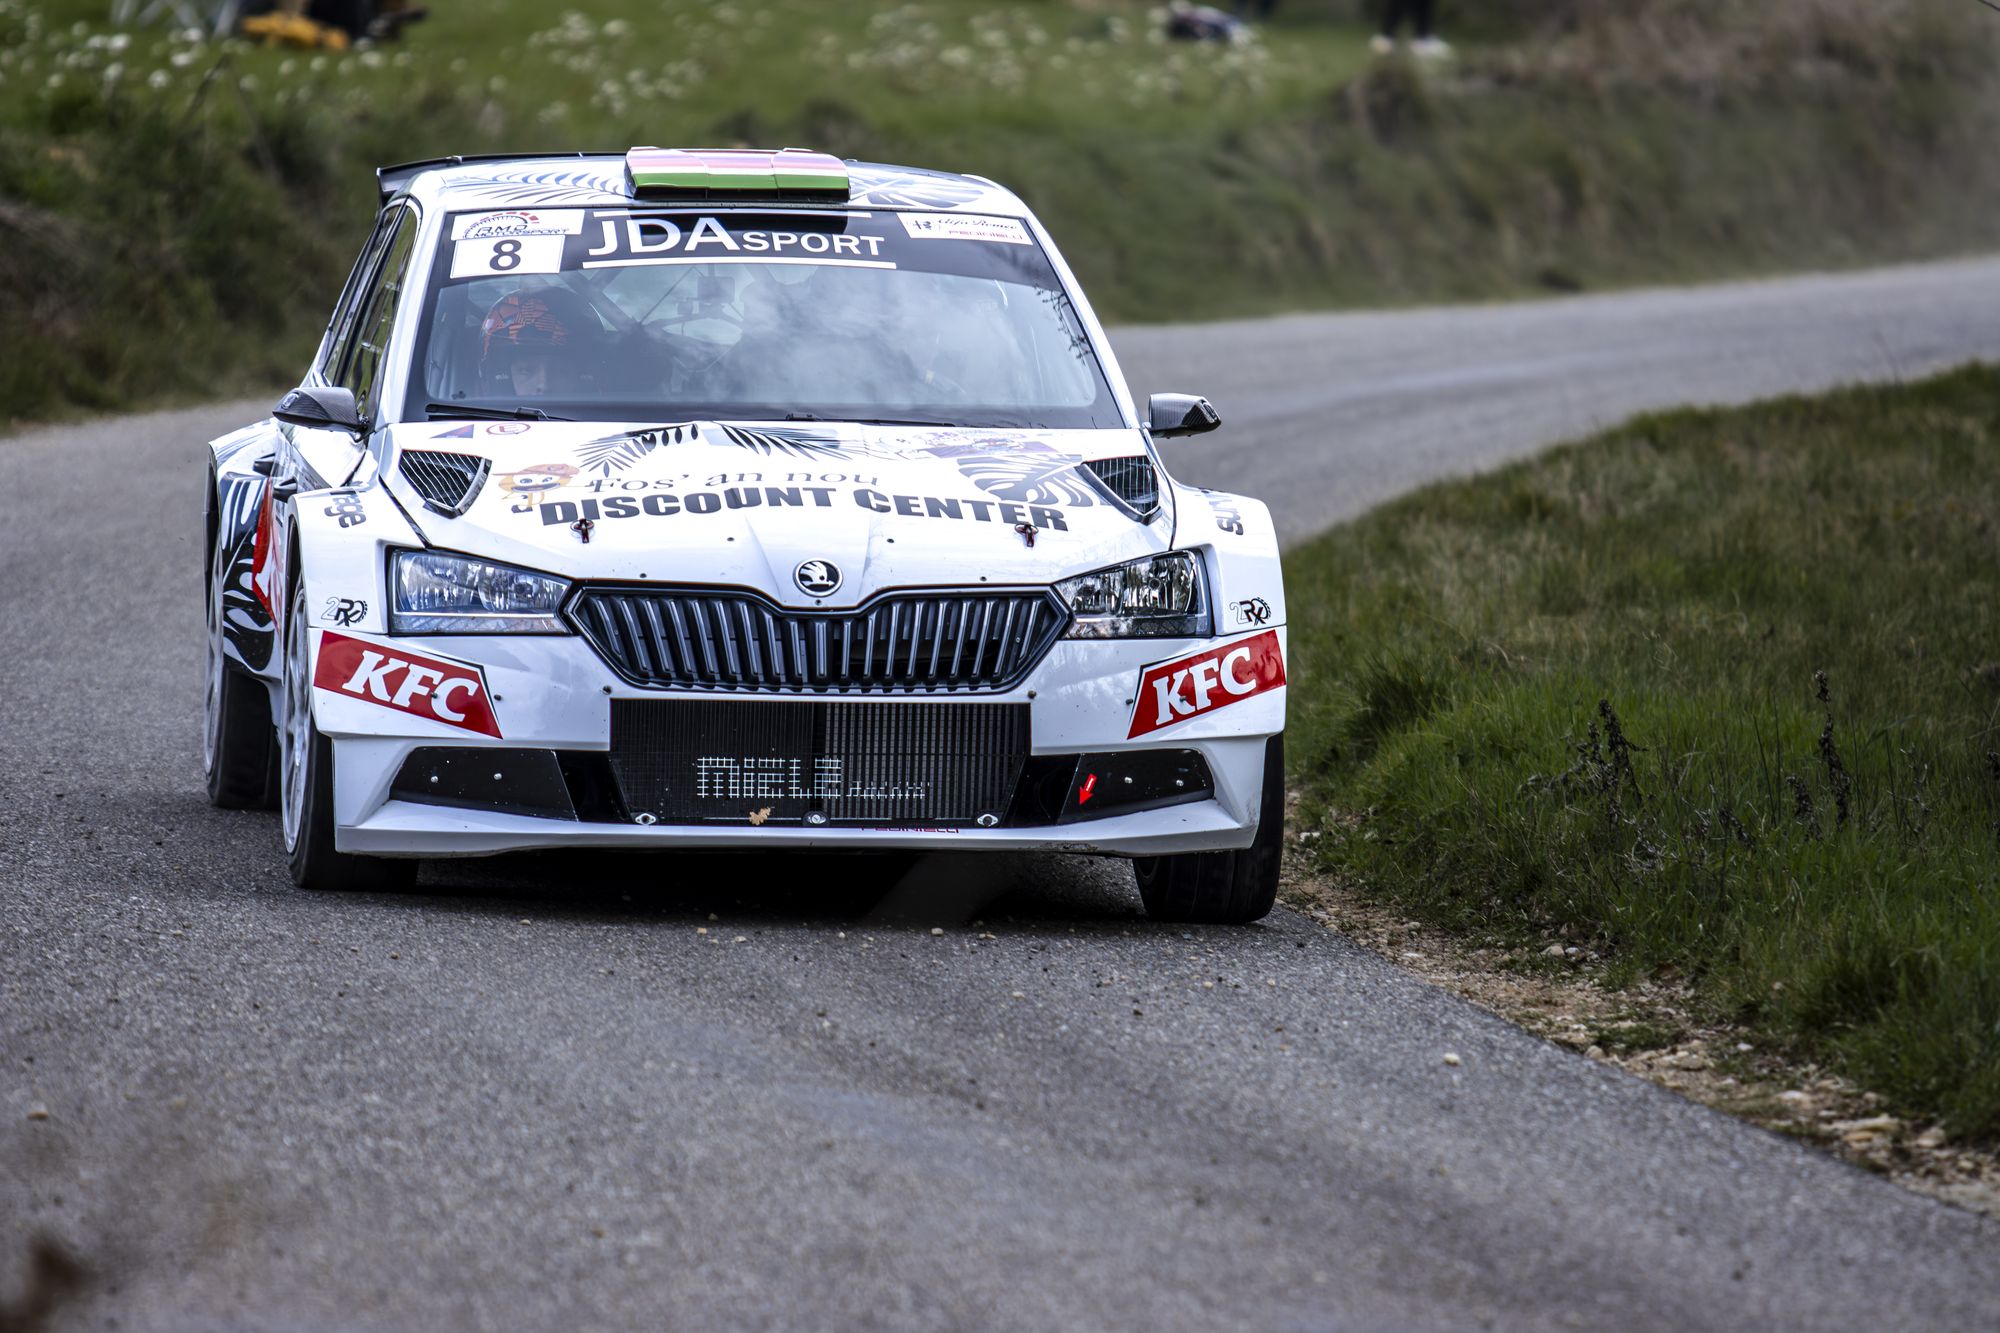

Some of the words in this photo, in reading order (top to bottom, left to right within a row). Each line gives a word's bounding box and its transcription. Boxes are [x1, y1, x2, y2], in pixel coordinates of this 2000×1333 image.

[489, 239, 522, 271] 8
[589, 217, 741, 256] JDA
[742, 231, 885, 256] SPORT
[705, 472, 764, 487] an
[786, 472, 878, 486] nou
[539, 487, 837, 526] DISCOUNT
[853, 488, 1069, 532] CENTER
[341, 650, 479, 722] KFC
[1152, 646, 1257, 726] KFC
